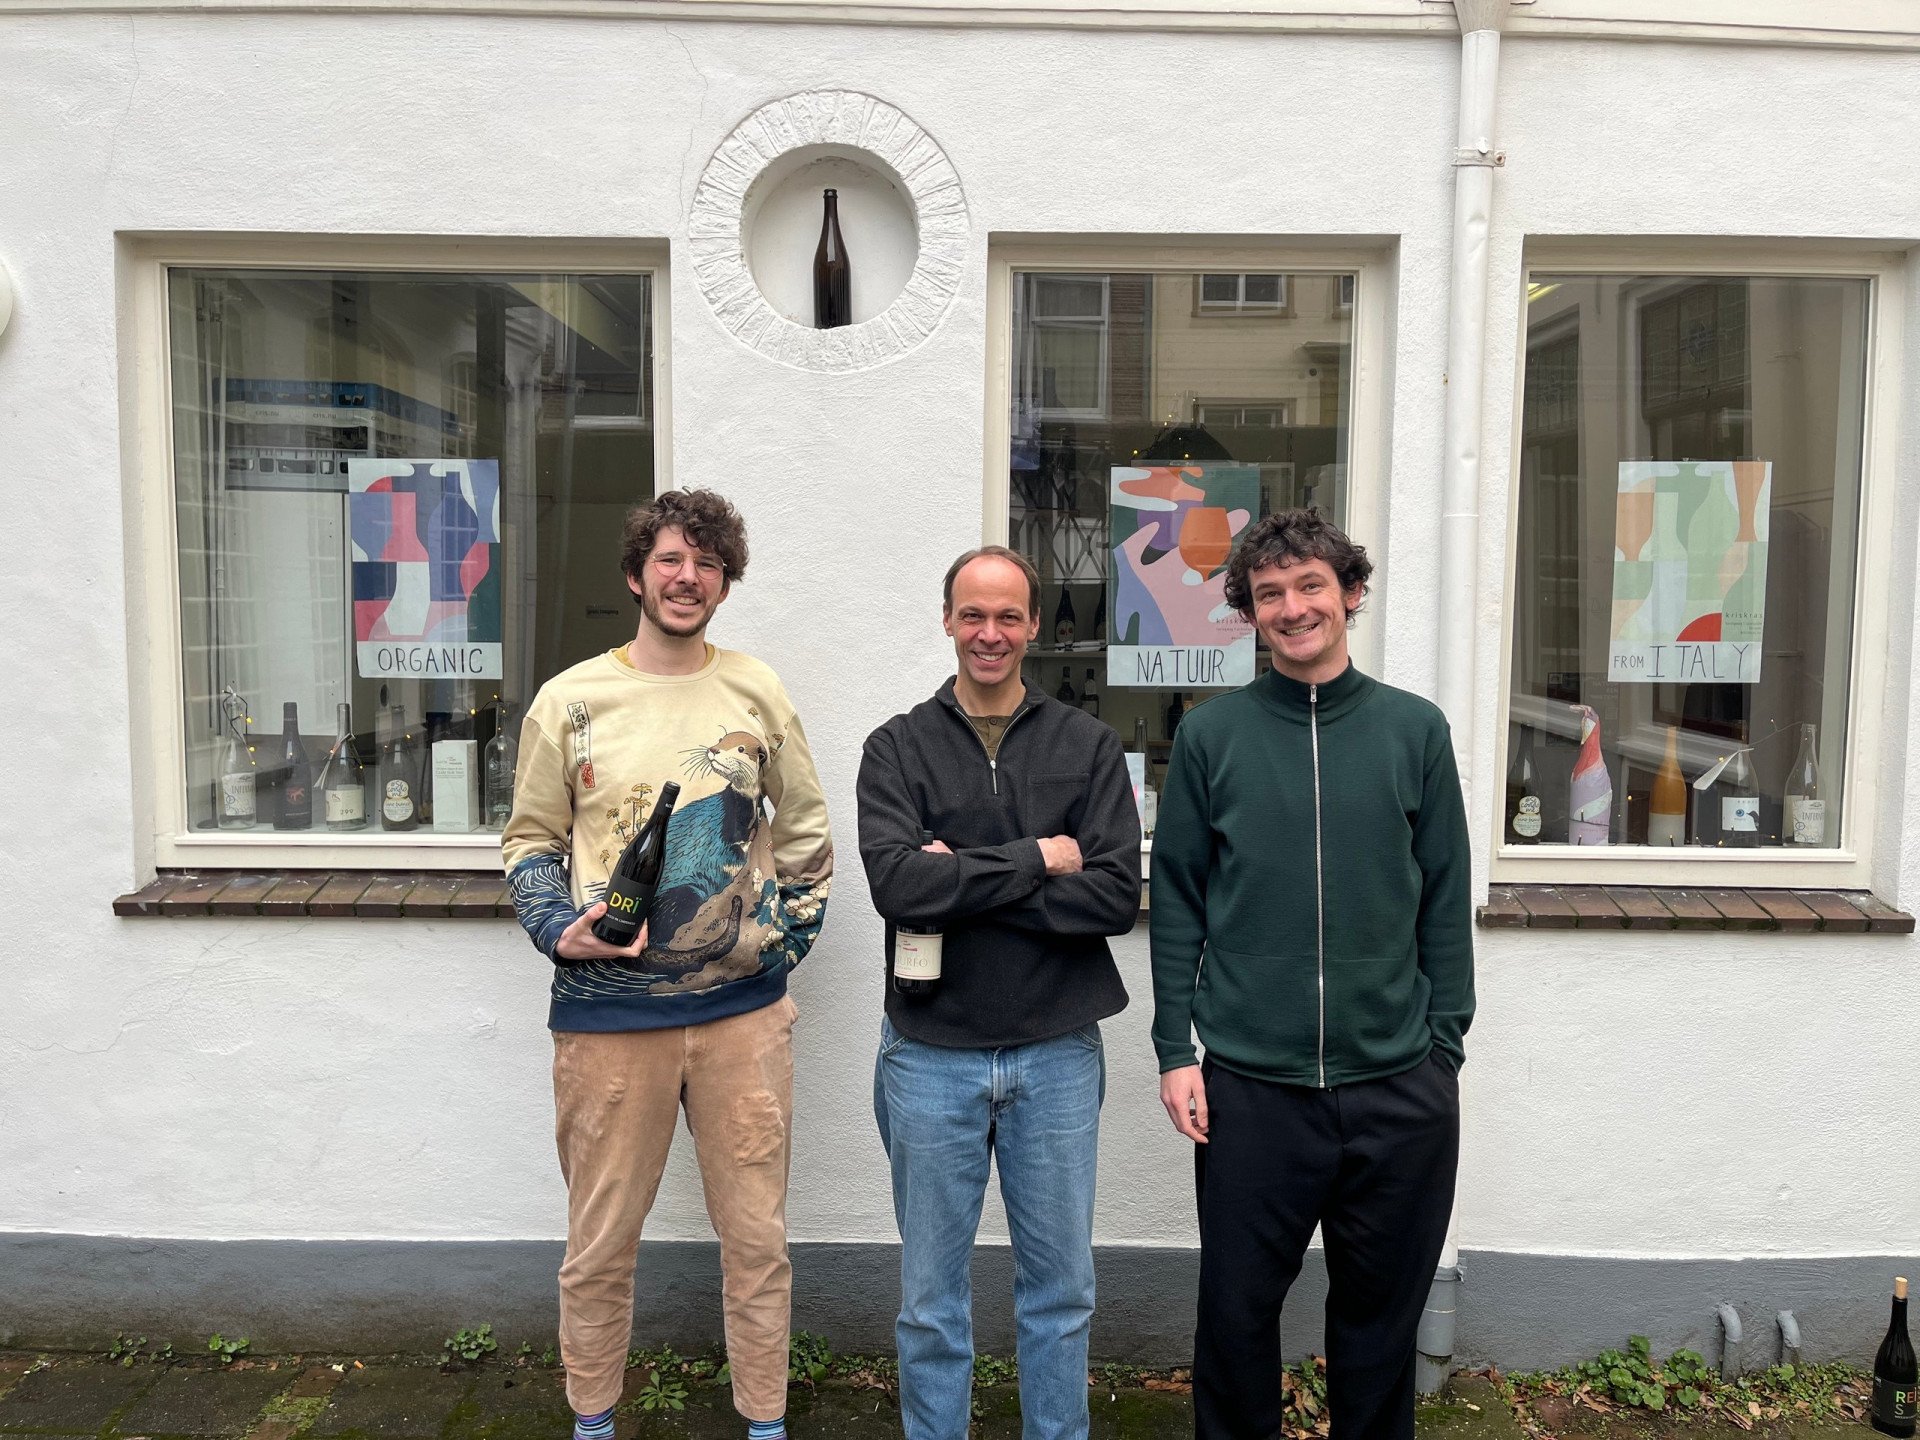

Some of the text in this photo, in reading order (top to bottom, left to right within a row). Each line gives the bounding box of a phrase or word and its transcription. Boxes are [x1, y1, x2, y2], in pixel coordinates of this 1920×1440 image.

[377, 647, 483, 674] ORGANIC
[1137, 648, 1225, 683] NATUUR
[1613, 643, 1749, 679] FROM ITALY
